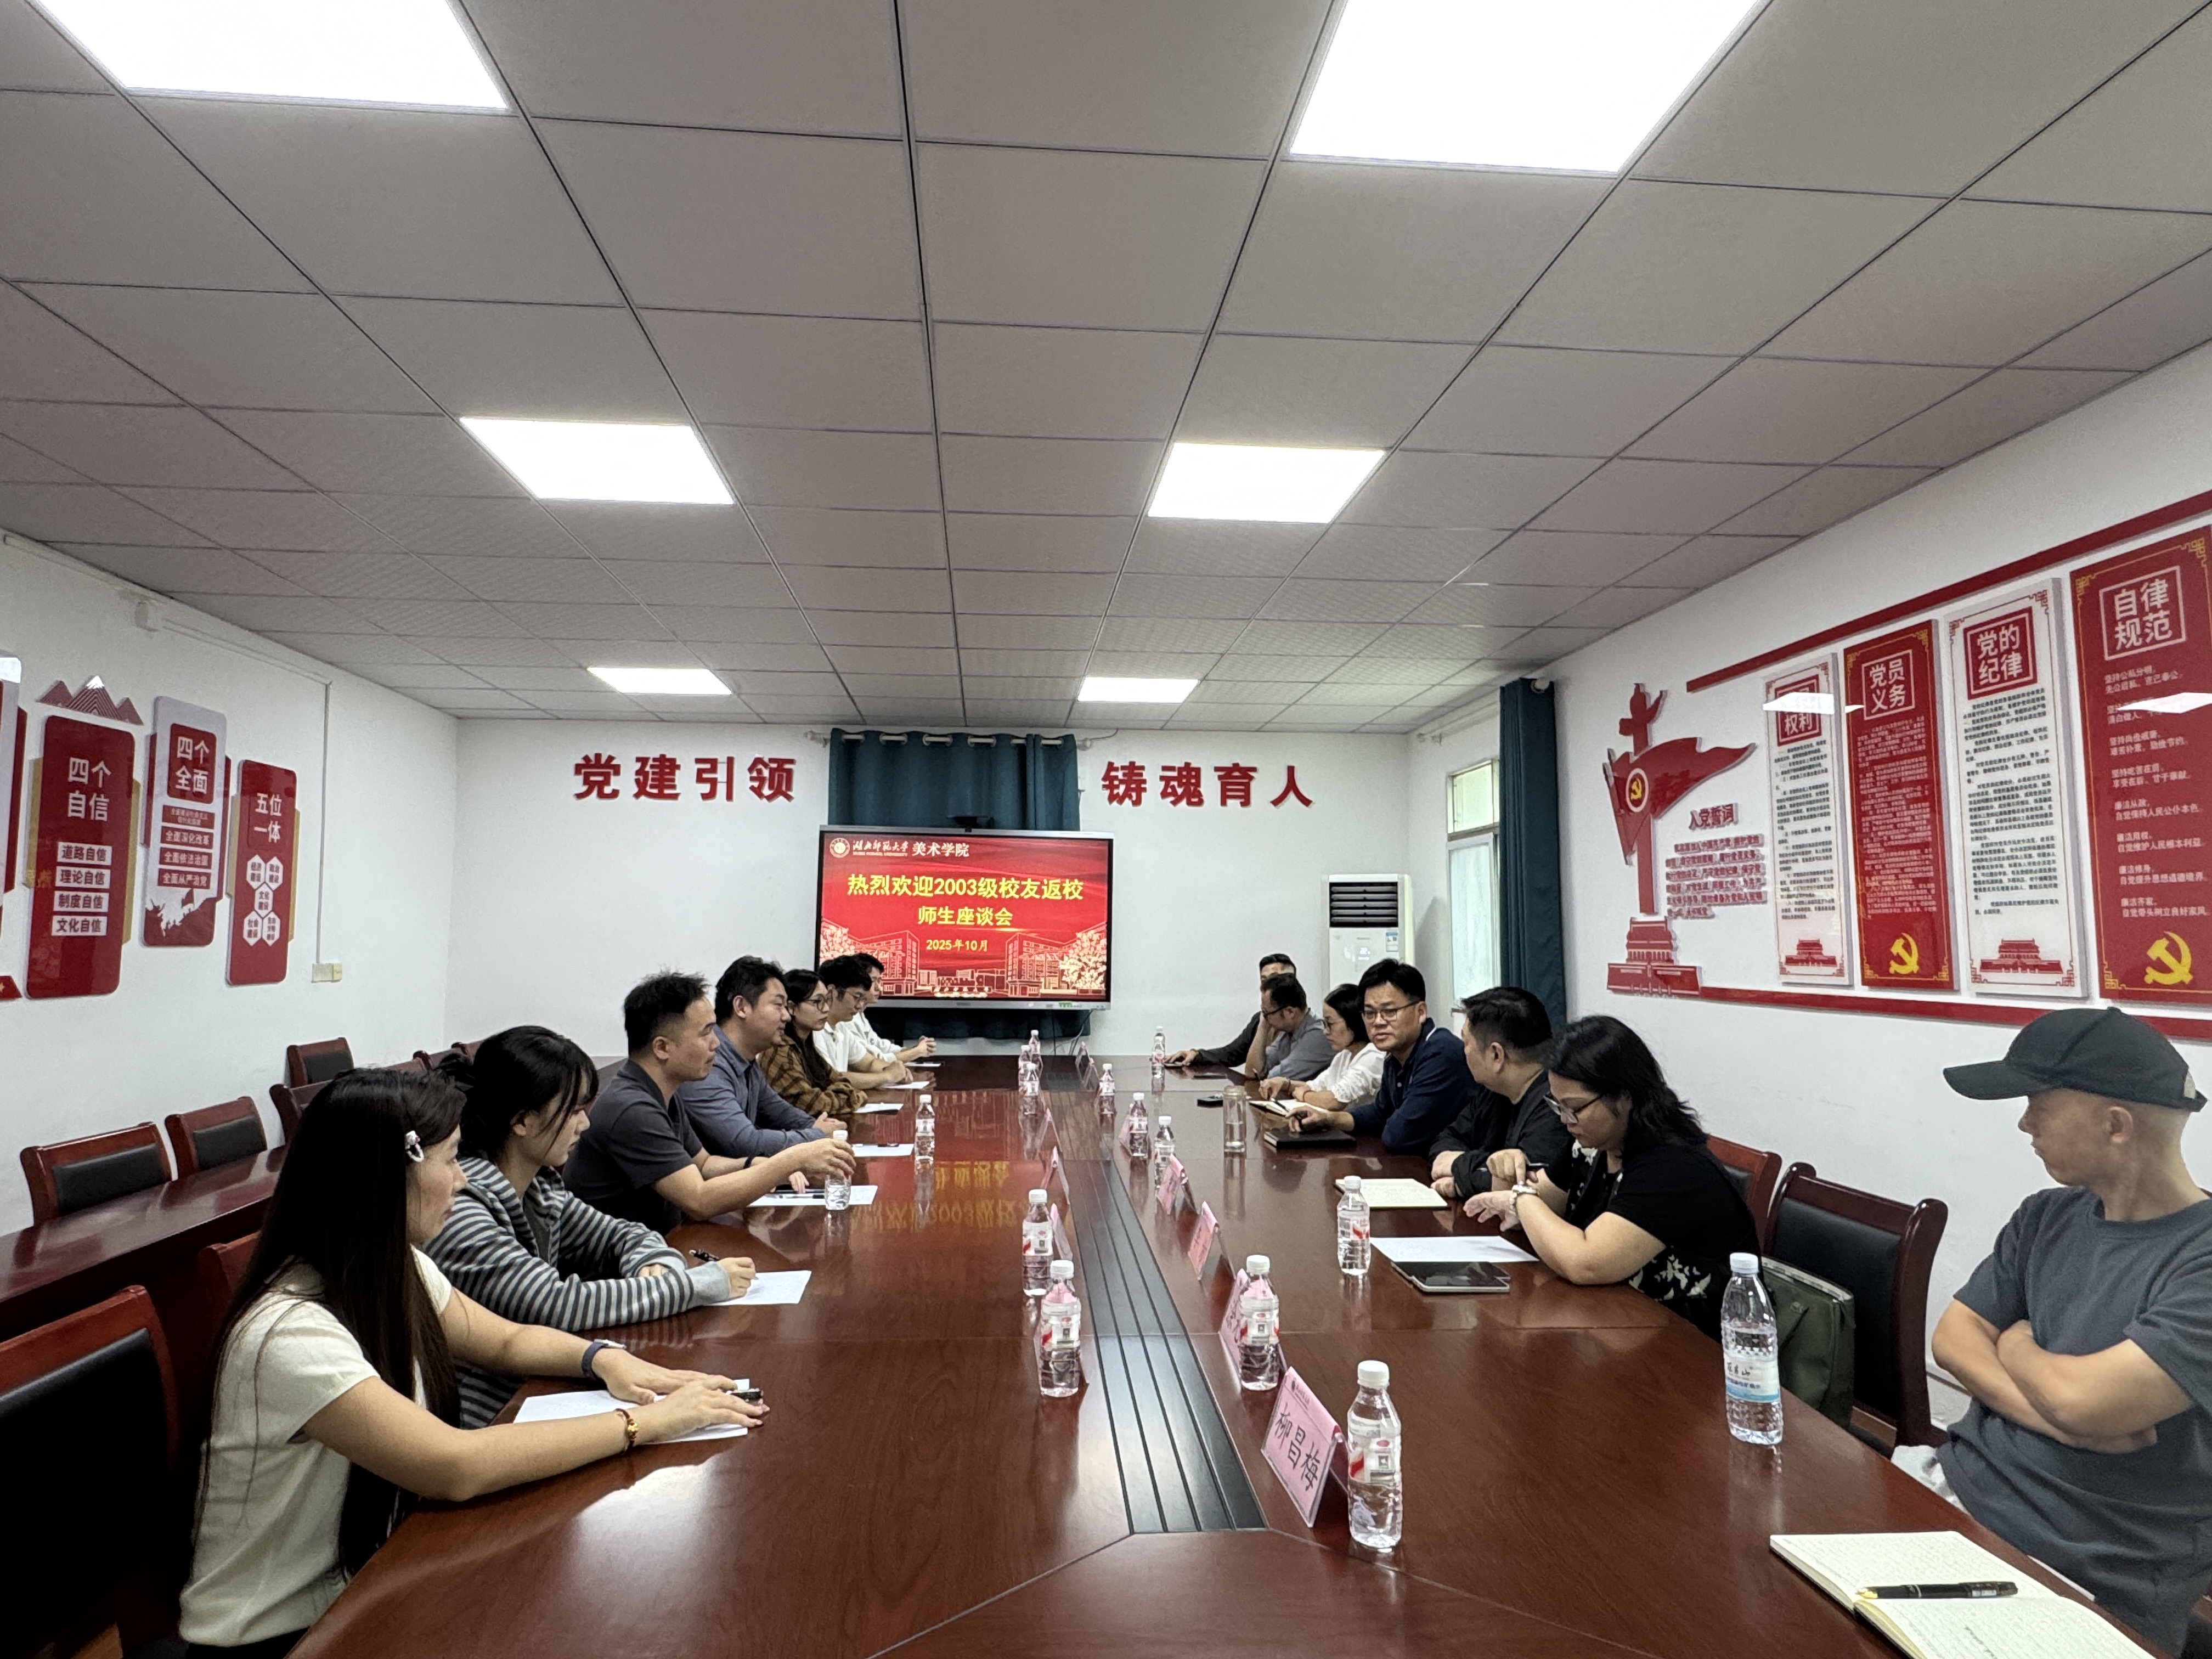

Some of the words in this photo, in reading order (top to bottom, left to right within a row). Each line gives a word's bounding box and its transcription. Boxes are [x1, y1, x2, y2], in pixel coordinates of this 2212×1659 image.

[2114, 579, 2169, 621] 自律
[1977, 624, 2021, 661] 党的
[2114, 609, 2172, 651] 规范
[1870, 659, 1905, 689] 党员
[1978, 651, 2023, 685] 纪律
[1871, 684, 1906, 713] 义务
[1785, 713, 1813, 736] 权利
[177, 736, 210, 764] 四个
[68, 757, 111, 788] 四个
[176, 765, 208, 794] 全面
[574, 753, 797, 803] 党建引领
[1102, 761, 1315, 808] 铸魂育人
[67, 790, 110, 822] 自信
[255, 793, 282, 816] 五位
[1689, 803, 1735, 829] 入党誓词
[166, 831, 210, 845] 全面深化改革
[253, 821, 281, 843] 一体
[61, 845, 108, 862] 道路自信
[165, 851, 208, 867] 全面依法治国
[853, 839, 909, 852] 湖北师范大学
[912, 841, 970, 857] 美术学院
[60, 869, 105, 885] 理论自信
[162, 873, 207, 887] 全面从严治党
[847, 874, 1084, 900] 热烈欢迎2003级校友返校
[58, 894, 104, 909] 制度自信
[56, 918, 102, 933] 文化自信
[918, 906, 1014, 926] 师生座谈会
[926, 939, 989, 952] 2025年10月
